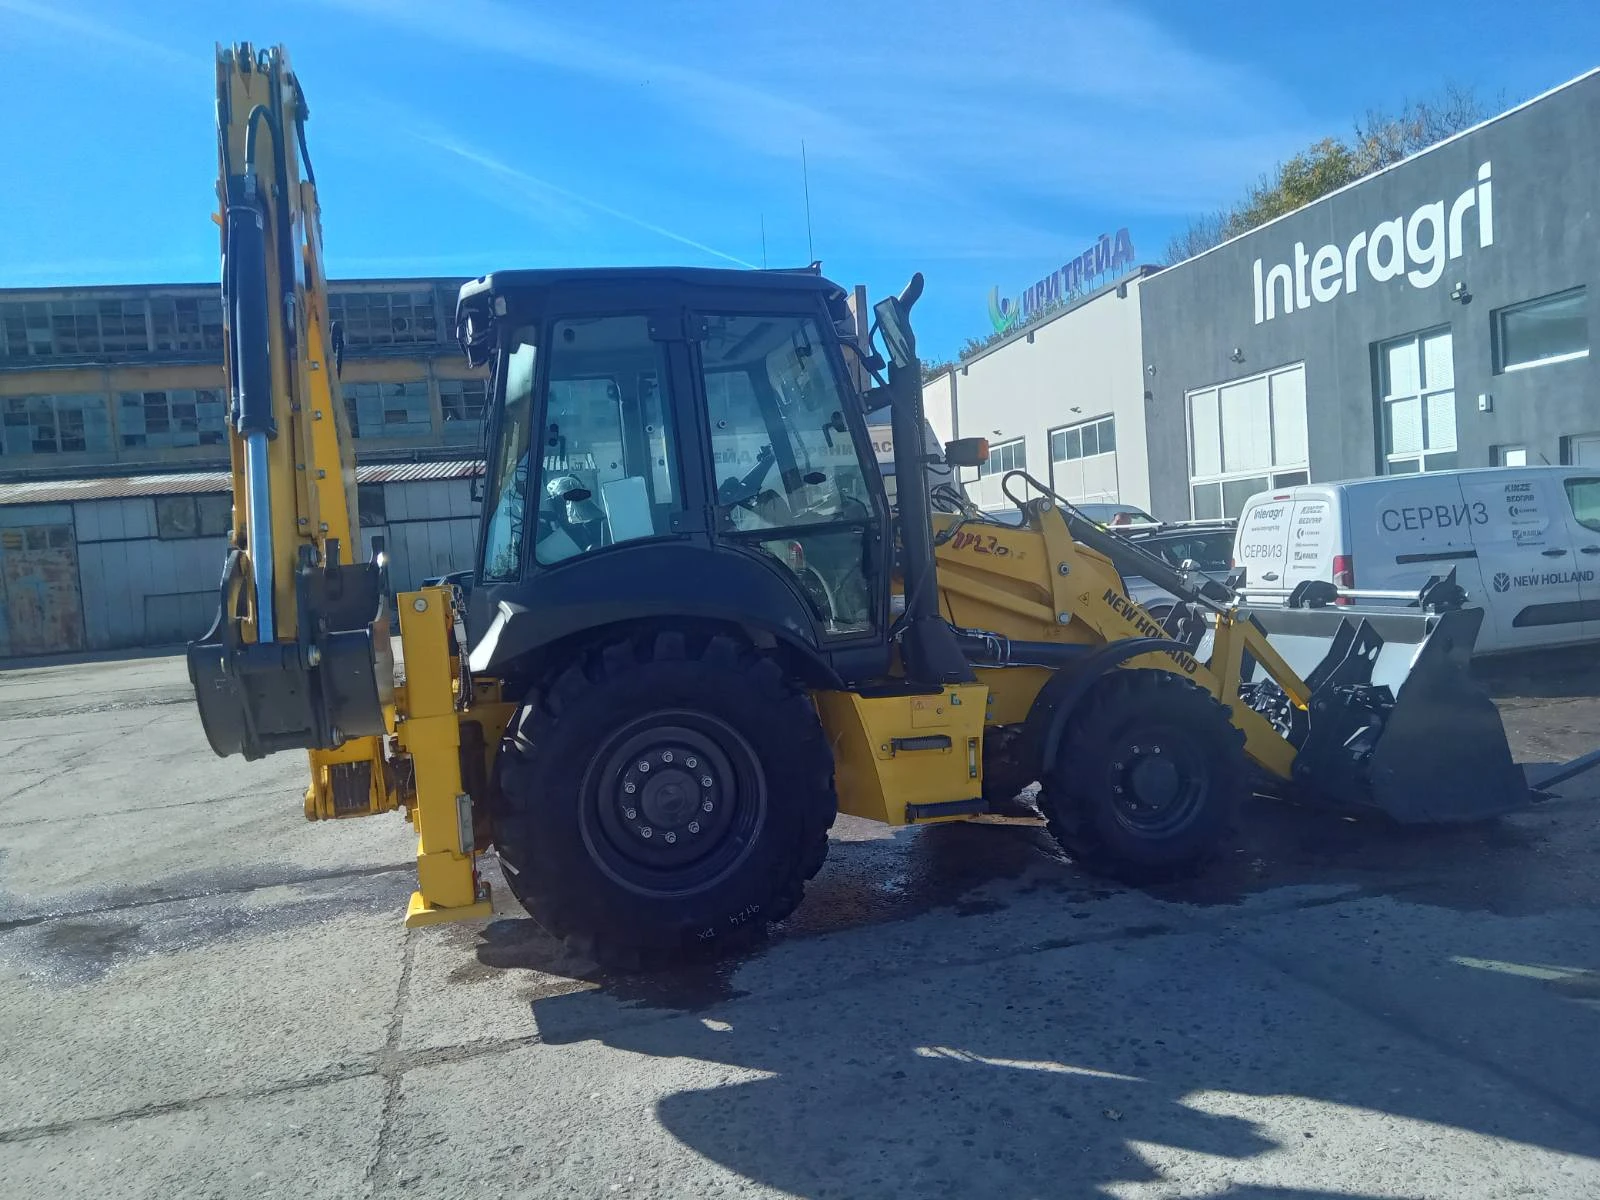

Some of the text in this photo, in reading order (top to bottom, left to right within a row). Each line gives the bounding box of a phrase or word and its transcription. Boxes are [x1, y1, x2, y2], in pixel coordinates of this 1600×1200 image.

[1254, 160, 1494, 325] Interagri
[1061, 227, 1135, 292] ТРЕЙД
[1253, 506, 1285, 521] Interagri
[1382, 502, 1489, 532] СЕРВИЗ
[1244, 544, 1283, 558] СЕРВИЗ
[1513, 570, 1594, 587] NEW HOLLAND
[1102, 588, 1198, 674] NEW HOAND
